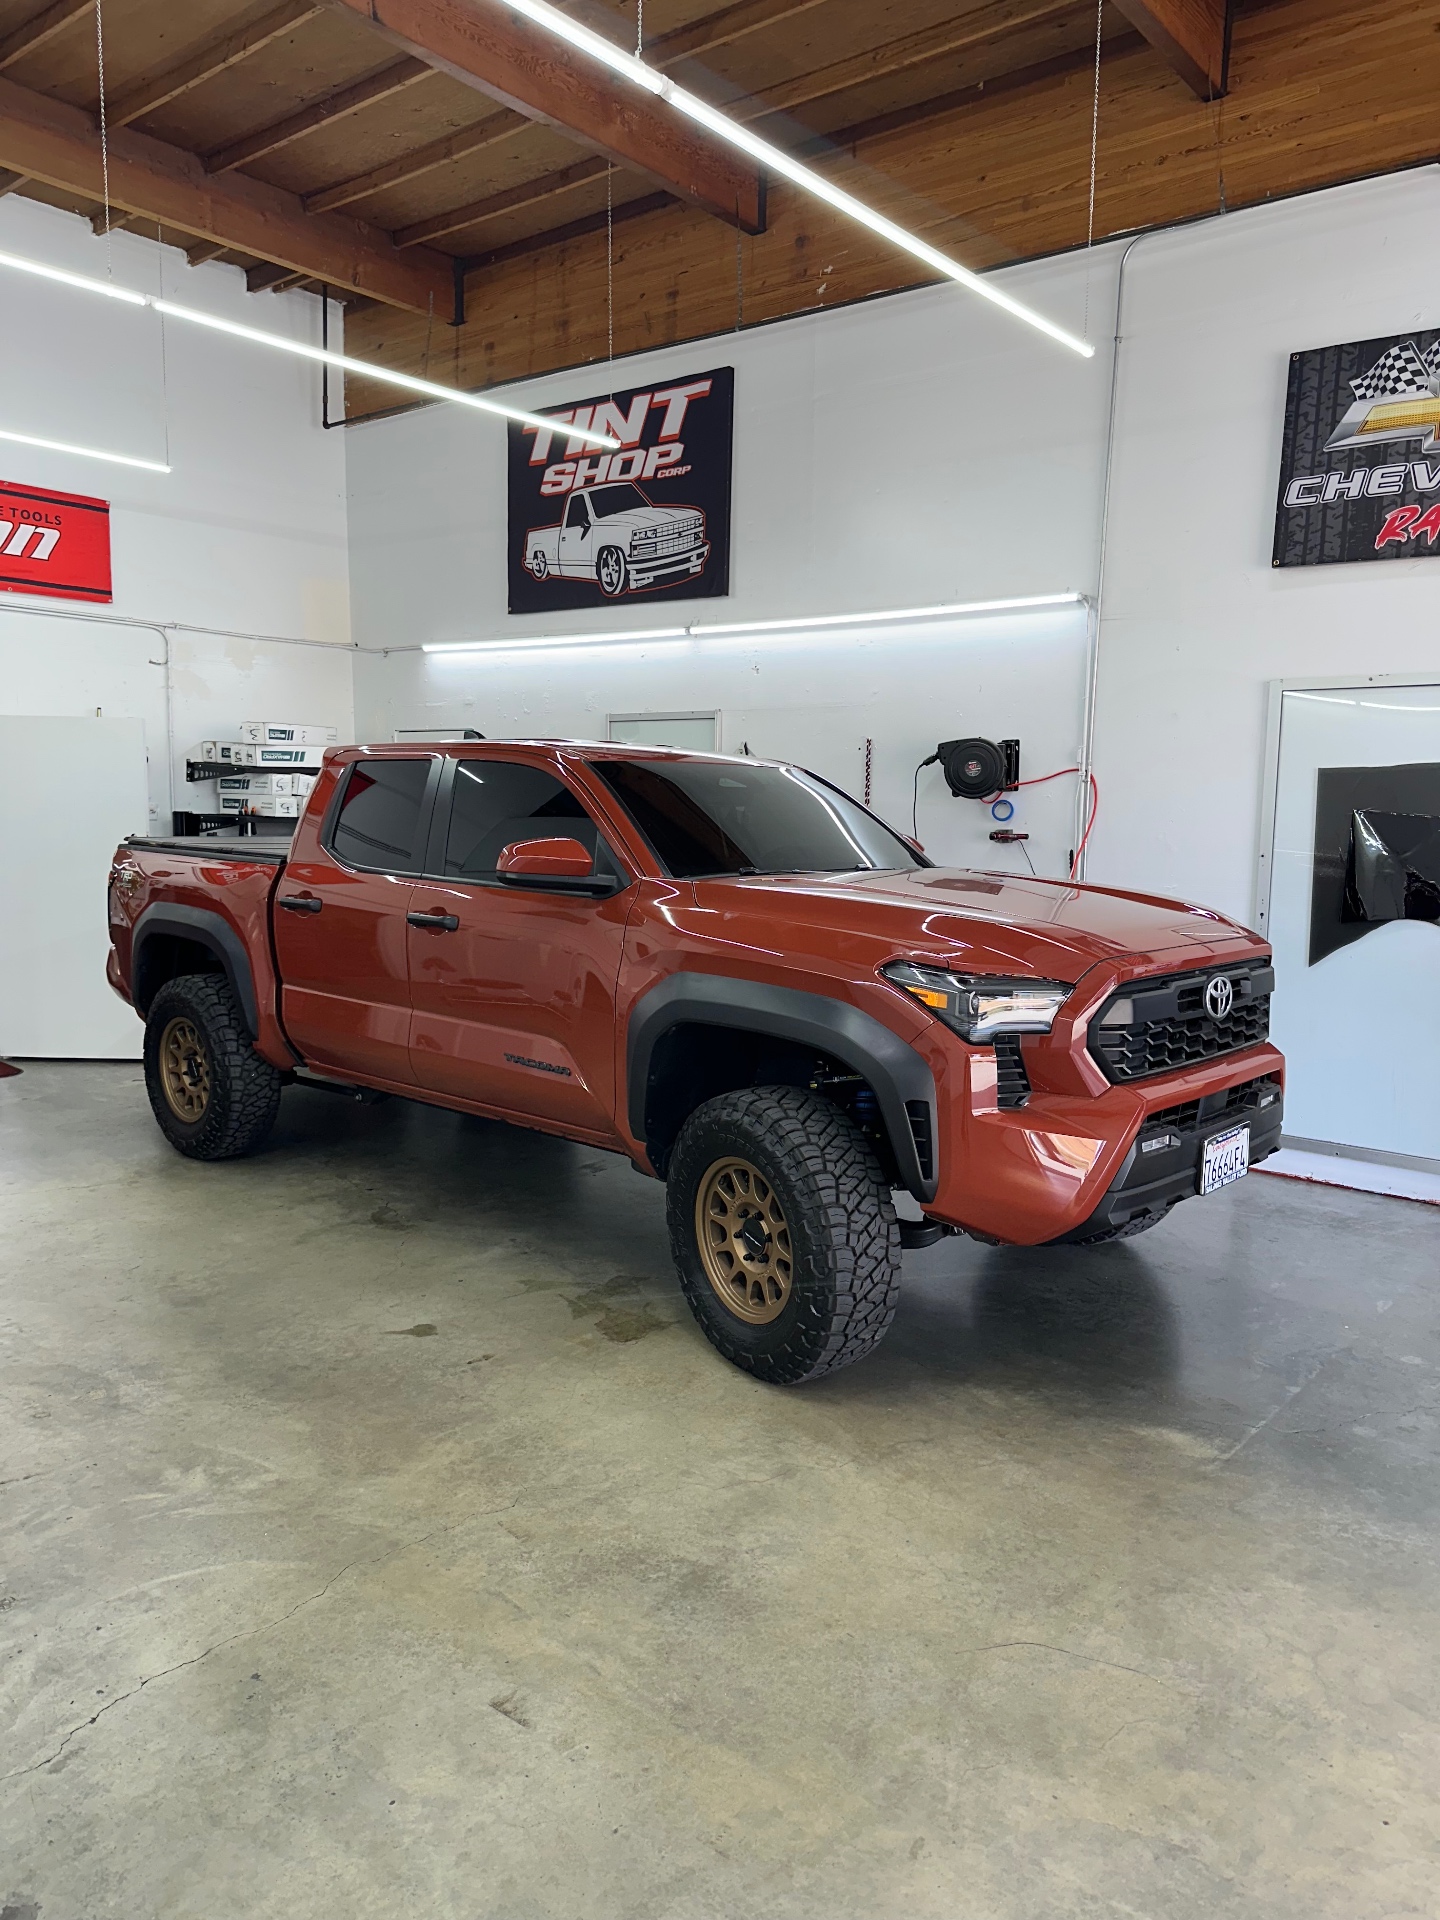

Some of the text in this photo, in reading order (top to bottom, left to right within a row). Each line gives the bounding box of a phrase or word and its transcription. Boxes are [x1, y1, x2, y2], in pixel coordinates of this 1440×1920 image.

[522, 379, 713, 466] TINT
[539, 442, 692, 496] SHOP CORP
[9, 507, 62, 526] TOOLS
[0, 519, 62, 561] n
[503, 1052, 571, 1076] TACOMA
[1205, 1144, 1245, 1185] 76664F4
